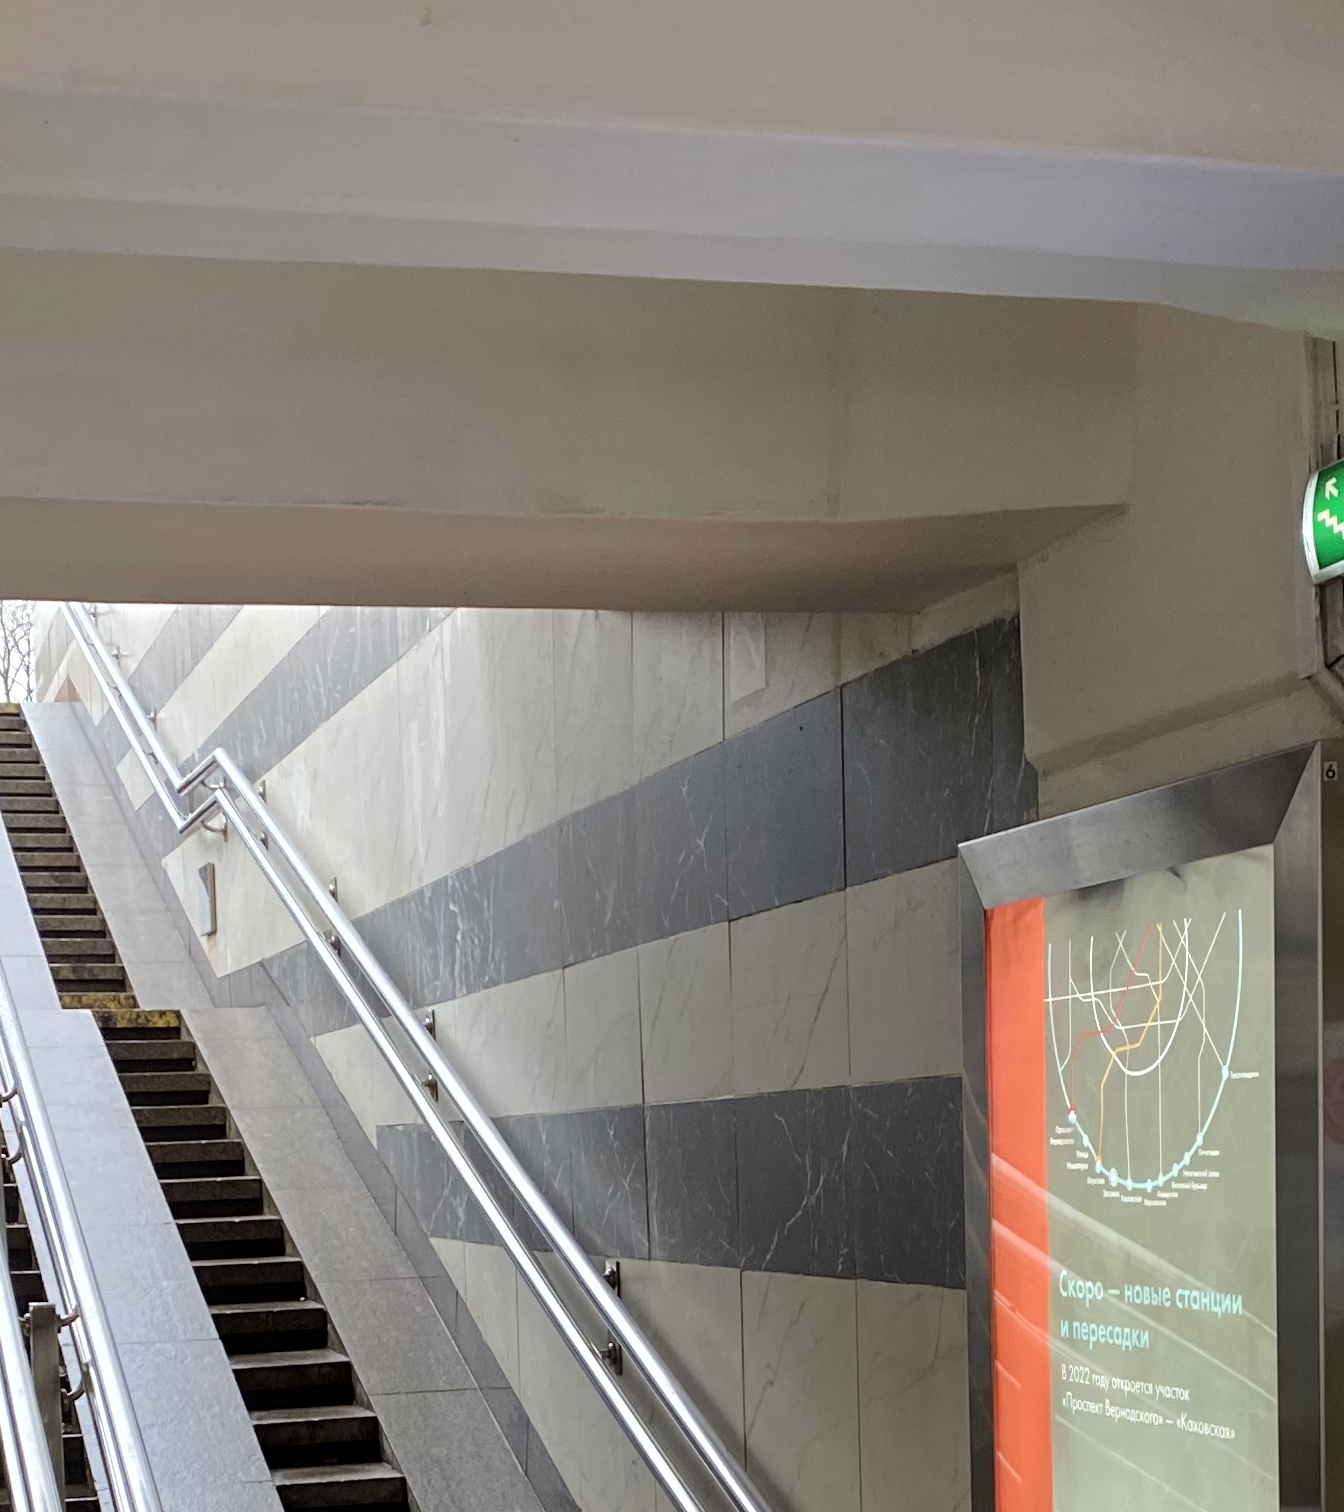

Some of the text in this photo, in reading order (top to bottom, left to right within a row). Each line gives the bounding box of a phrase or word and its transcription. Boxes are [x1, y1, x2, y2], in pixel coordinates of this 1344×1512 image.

[1326, 764, 1335, 779] 6
[1059, 1270, 1104, 1309] Скоро
[1124, 1283, 1171, 1307] новые
[1176, 1288, 1243, 1318] станции
[1059, 1318, 1150, 1352] и пересадки
[1062, 1364, 1190, 1402] В 2022 году откроется участок
[1063, 1391, 1103, 1416] «Проспект
[1105, 1399, 1163, 1426] Вернадского»
[1176, 1413, 1235, 1440] «Каховская»
